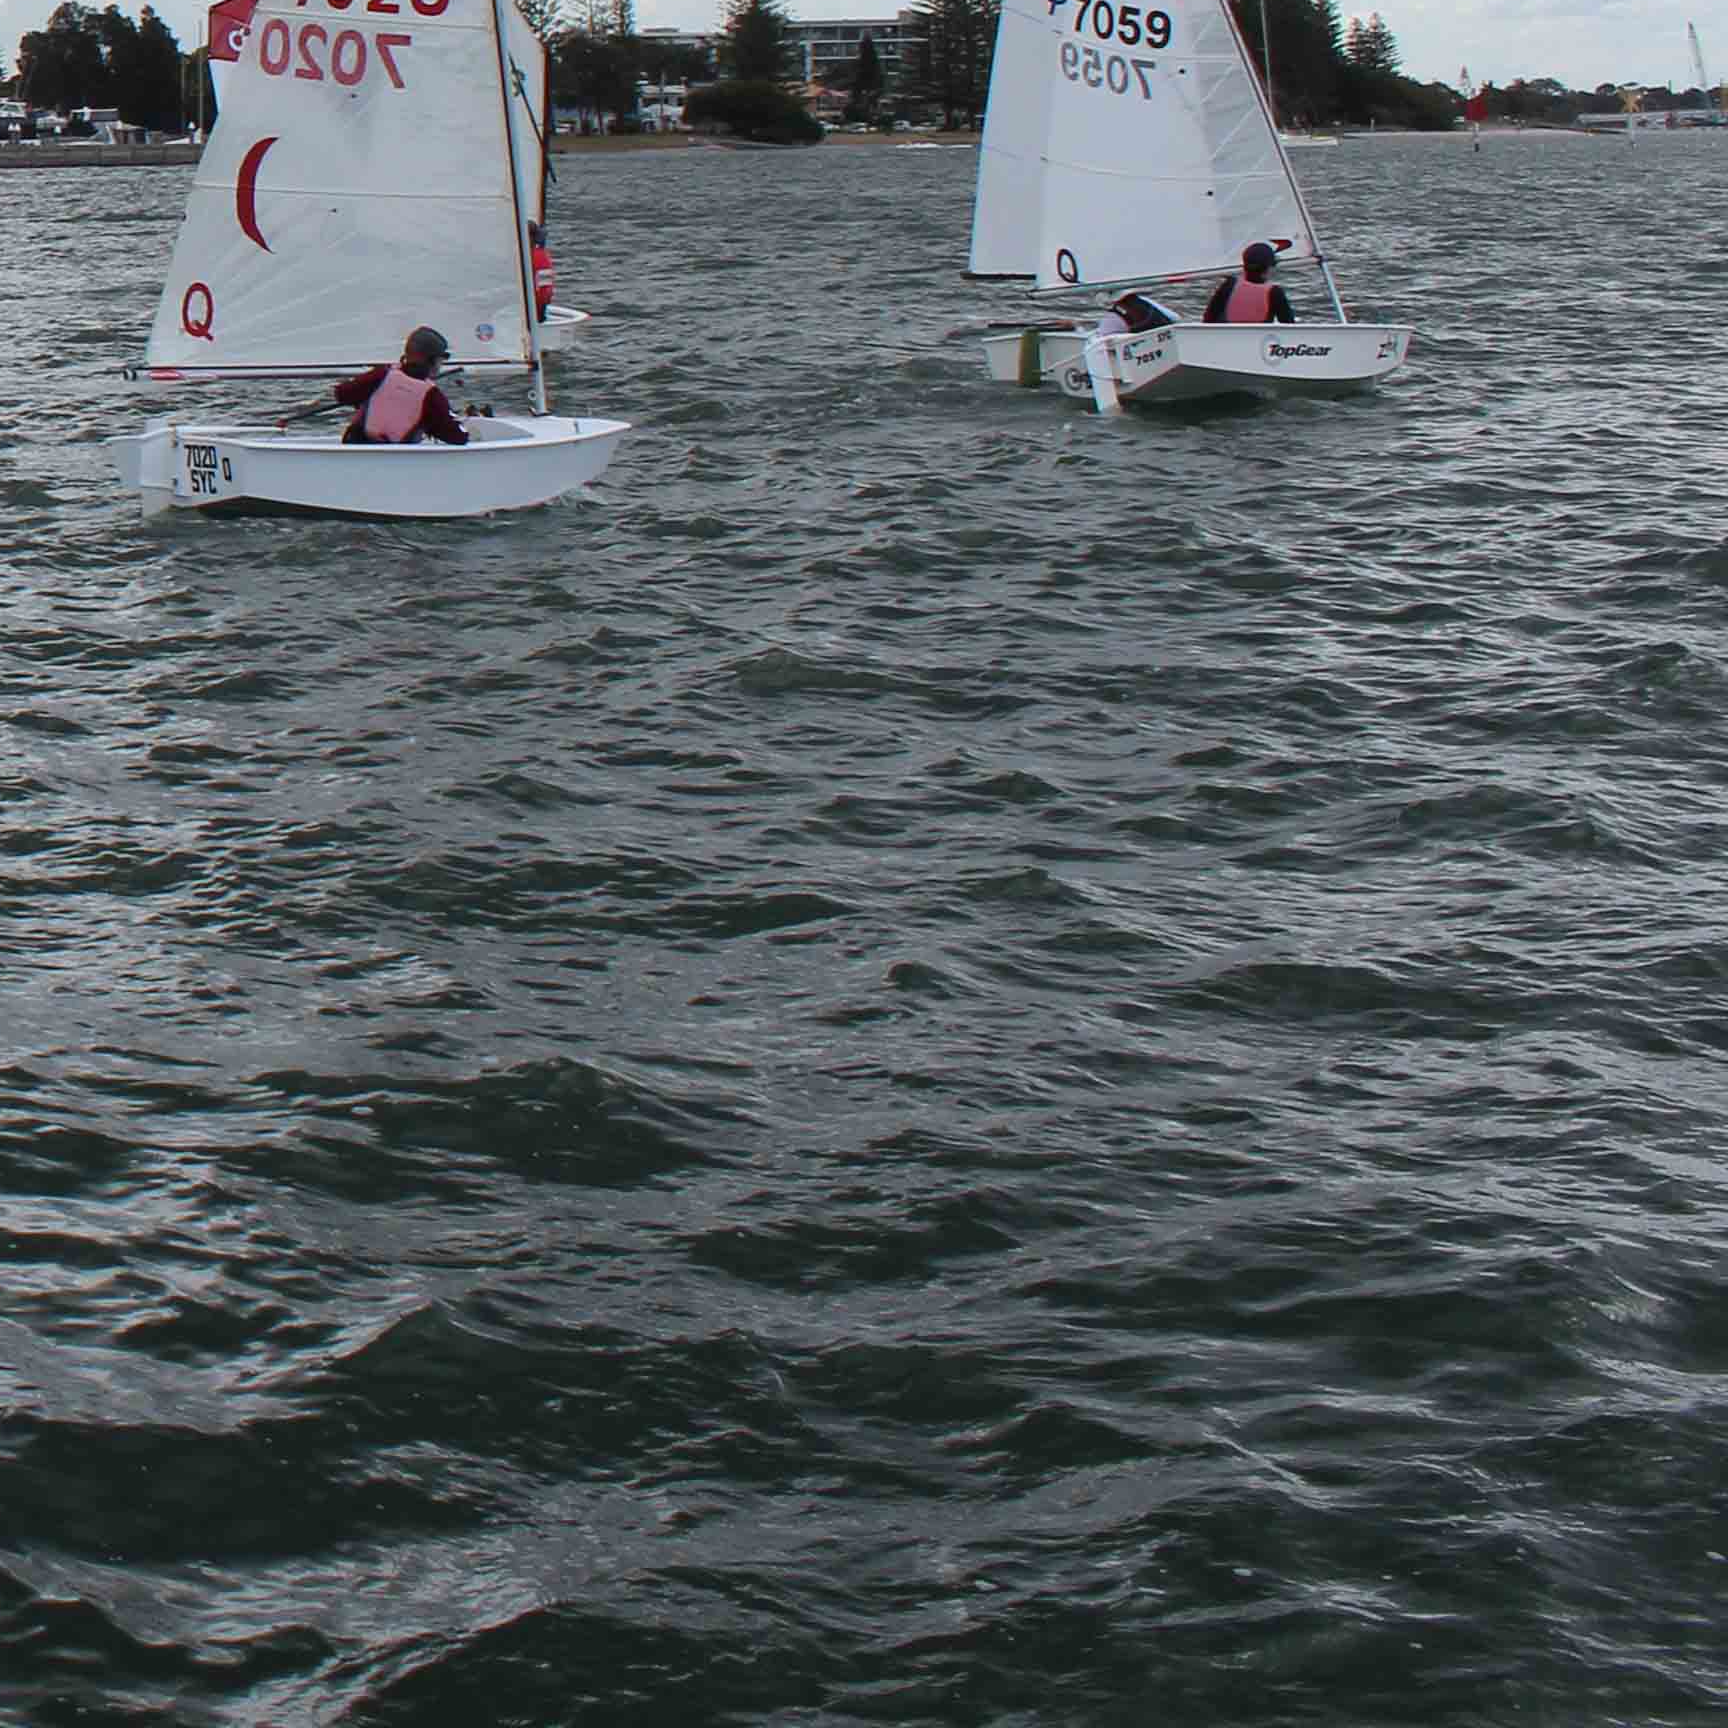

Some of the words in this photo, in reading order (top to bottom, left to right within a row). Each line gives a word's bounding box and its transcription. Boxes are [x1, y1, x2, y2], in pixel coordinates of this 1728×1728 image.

[1056, 248, 1079, 283] Q
[182, 282, 215, 341] Q
[184, 444, 217, 469] 7020
[191, 470, 217, 494] SYC
